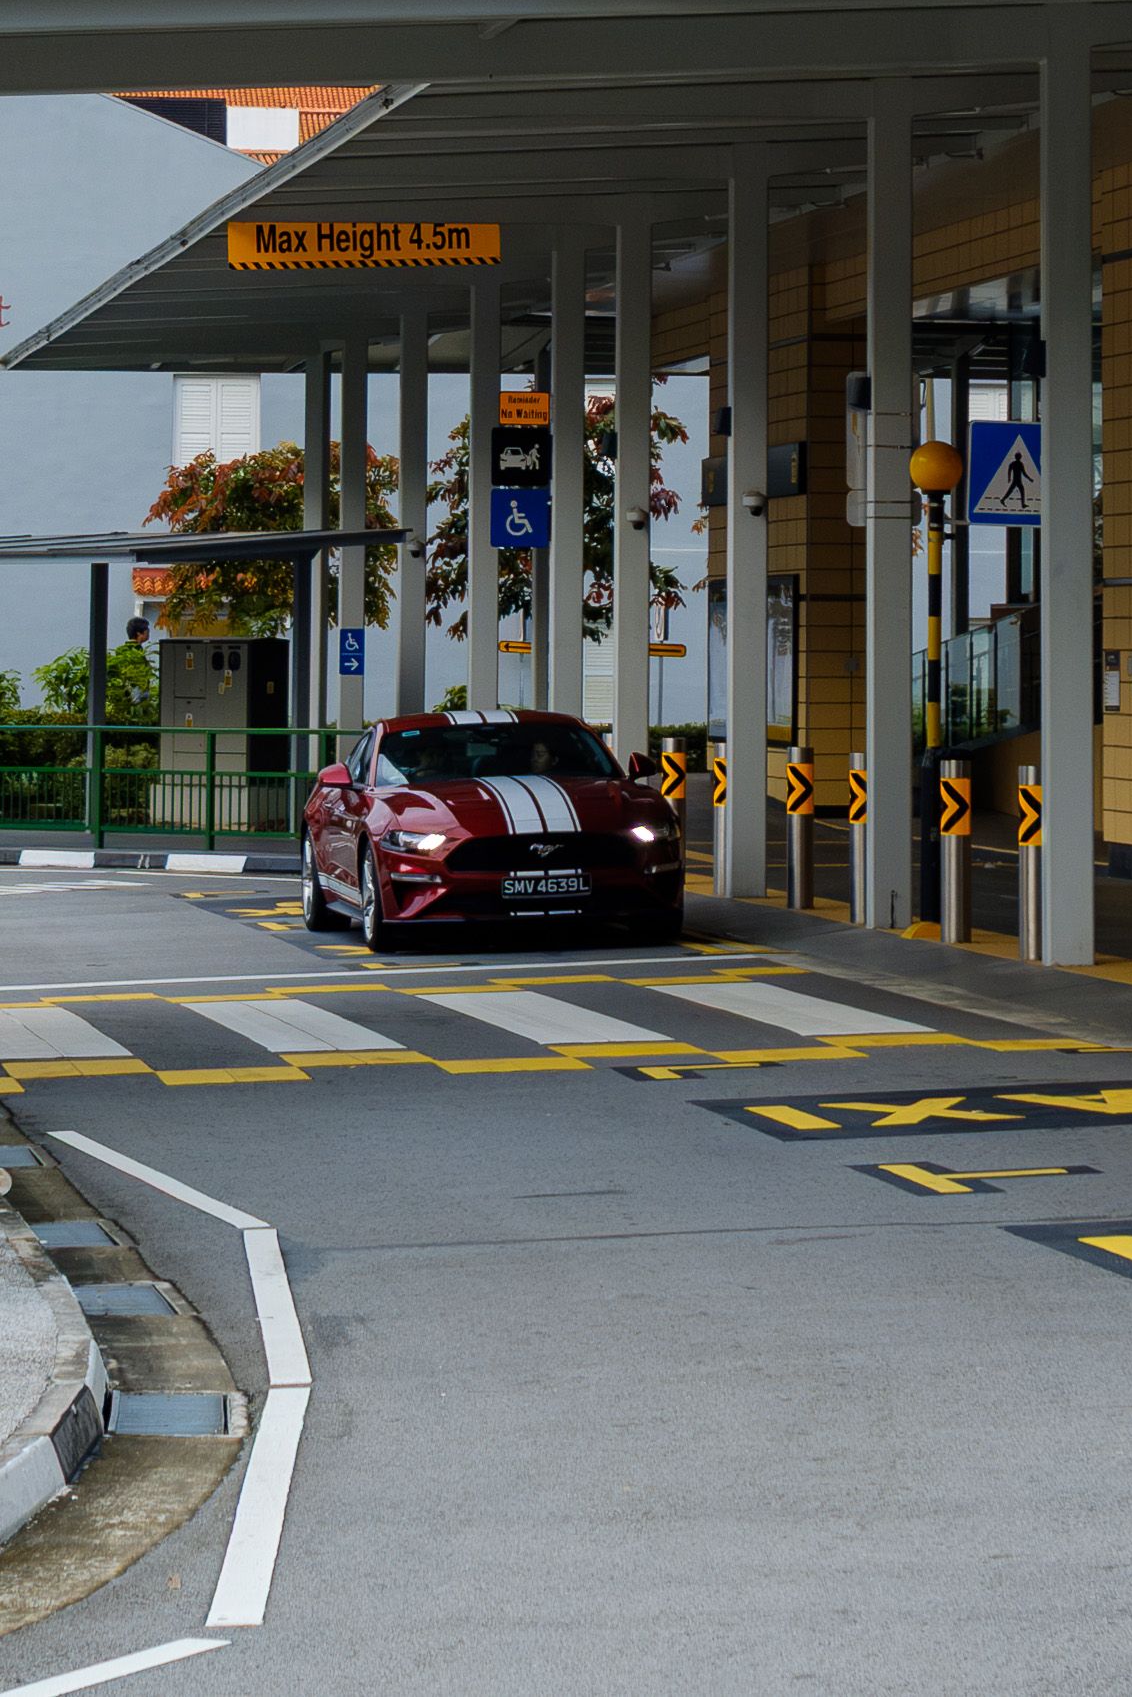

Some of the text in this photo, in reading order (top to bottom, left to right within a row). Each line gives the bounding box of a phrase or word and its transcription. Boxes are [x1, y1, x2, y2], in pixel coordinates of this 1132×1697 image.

[255, 221, 471, 259] Max Height 4.5m
[501, 408, 548, 422] No Waiting
